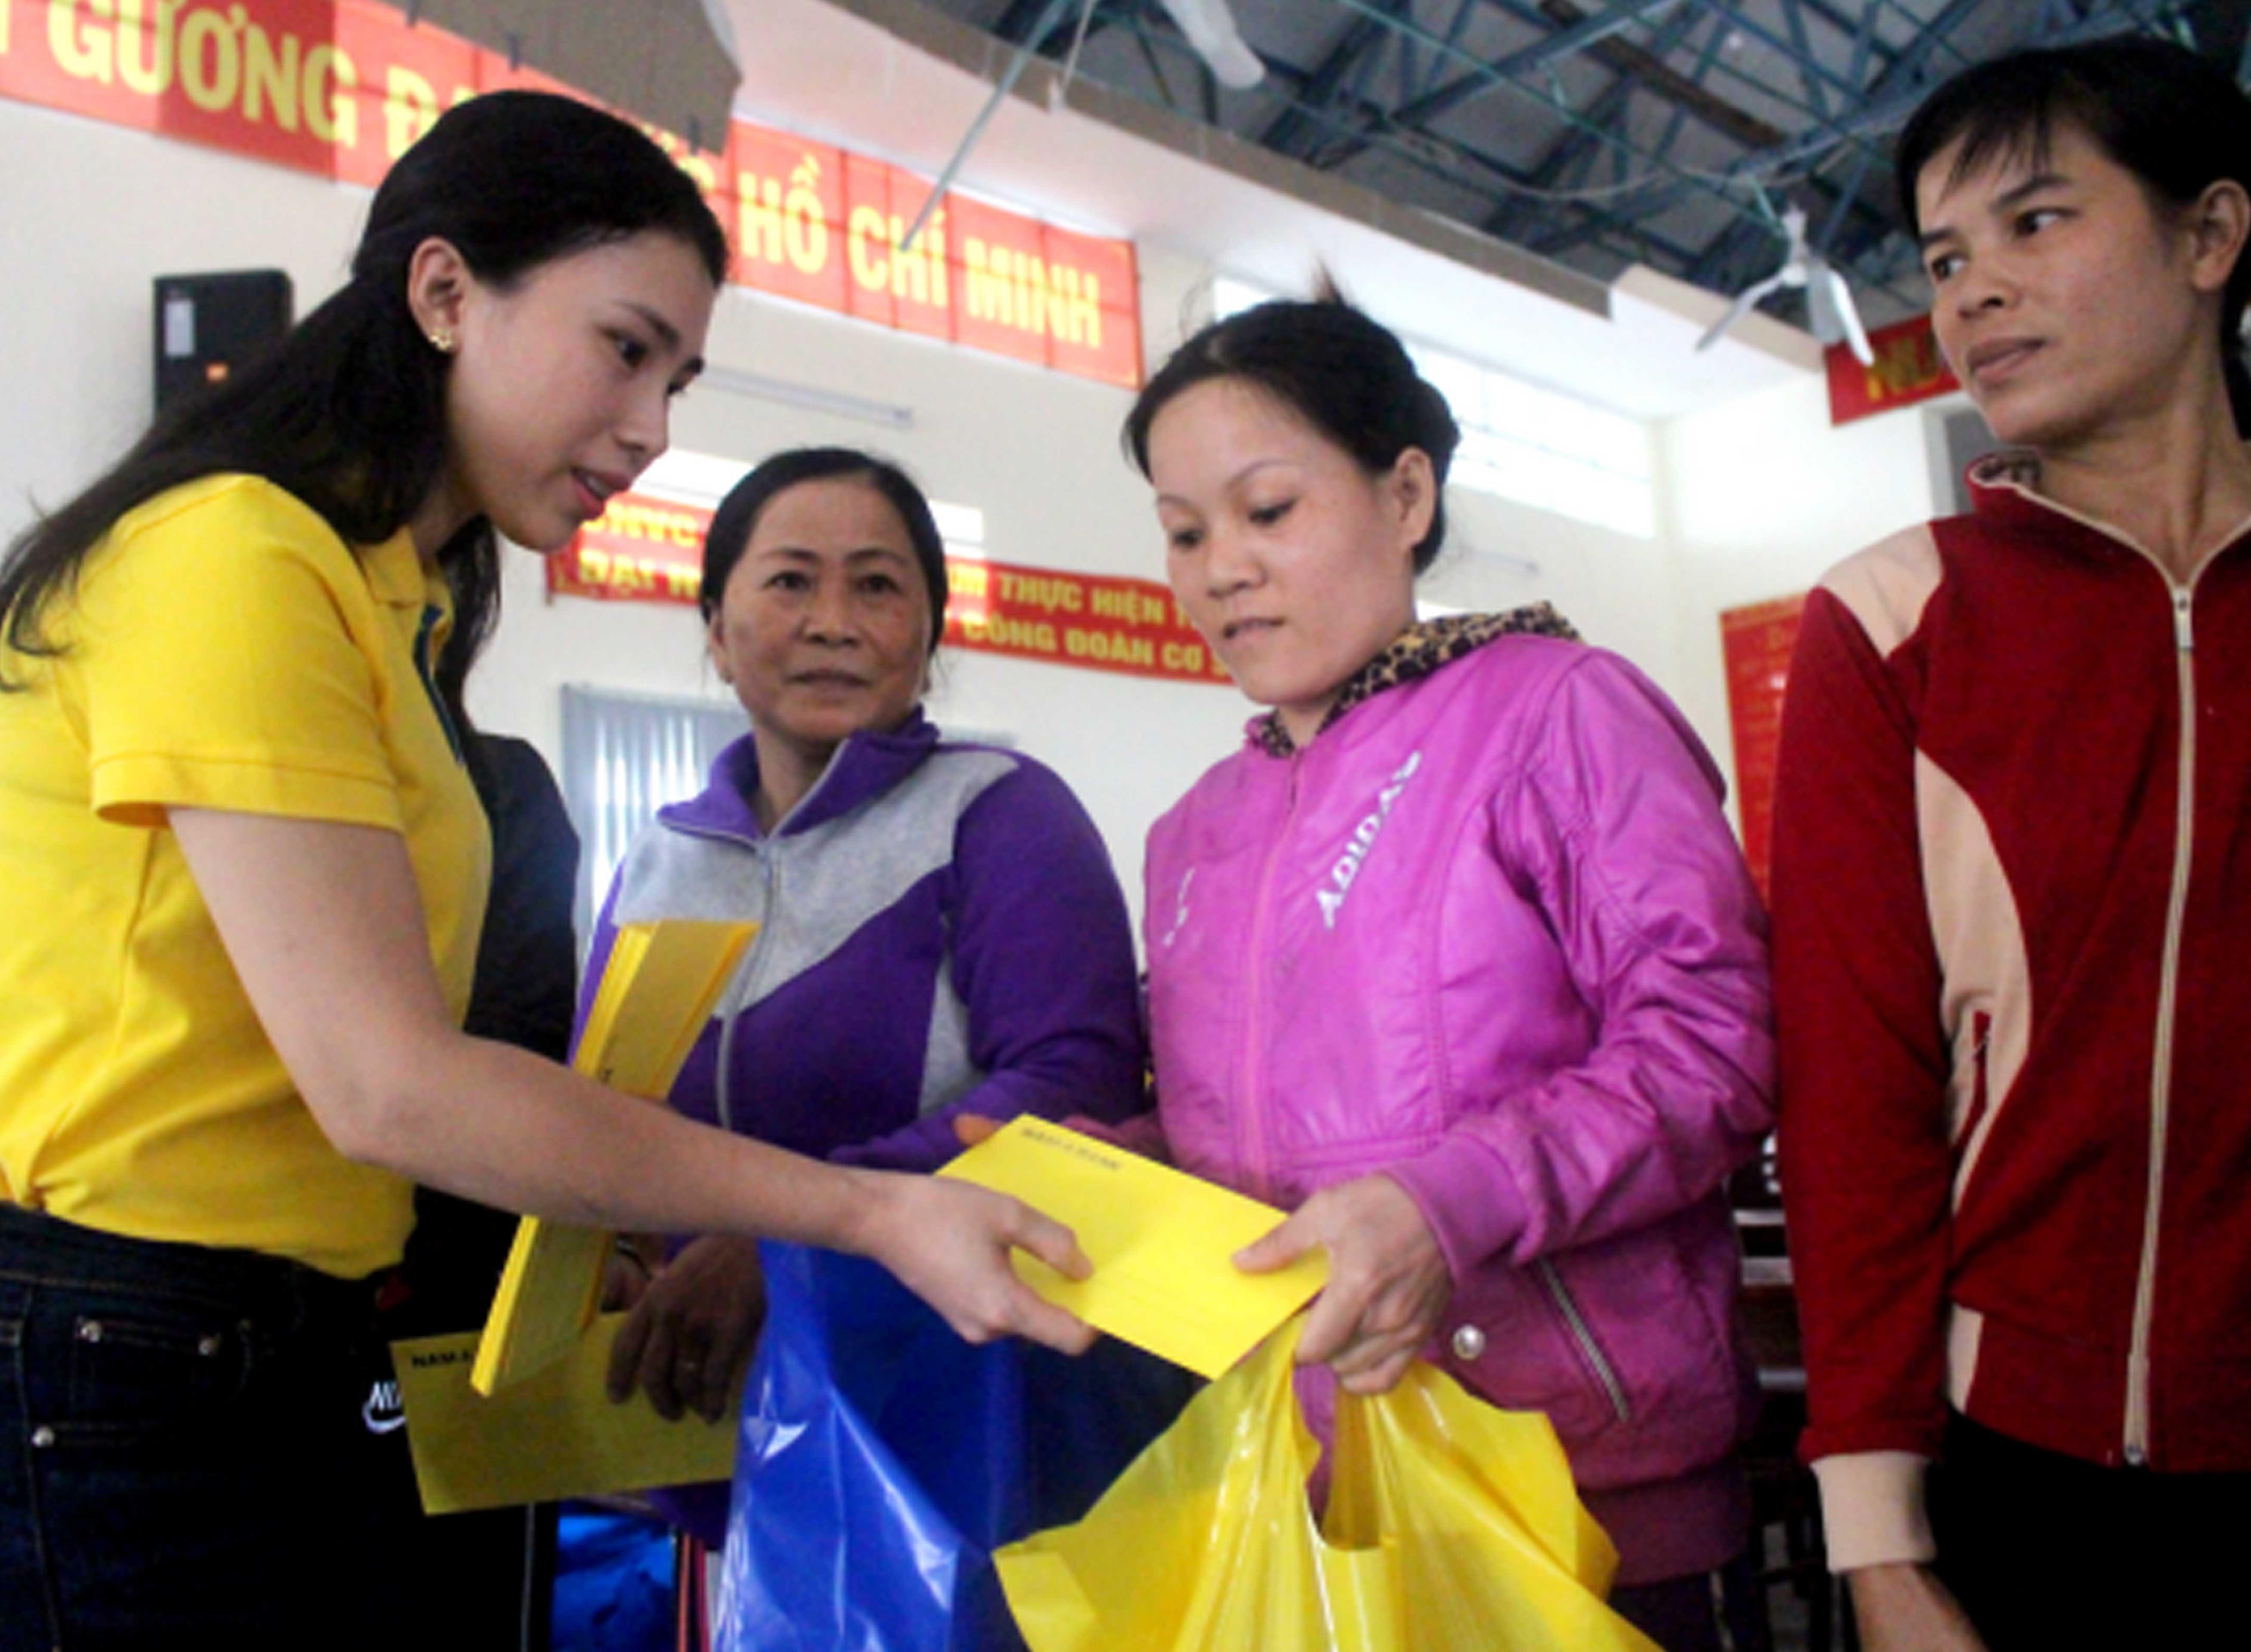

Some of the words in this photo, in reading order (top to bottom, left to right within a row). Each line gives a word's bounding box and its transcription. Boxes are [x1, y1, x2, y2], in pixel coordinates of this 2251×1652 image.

[738, 153, 827, 275] HỒ
[847, 204, 949, 308] CHÍ
[964, 237, 1101, 348] MINH
